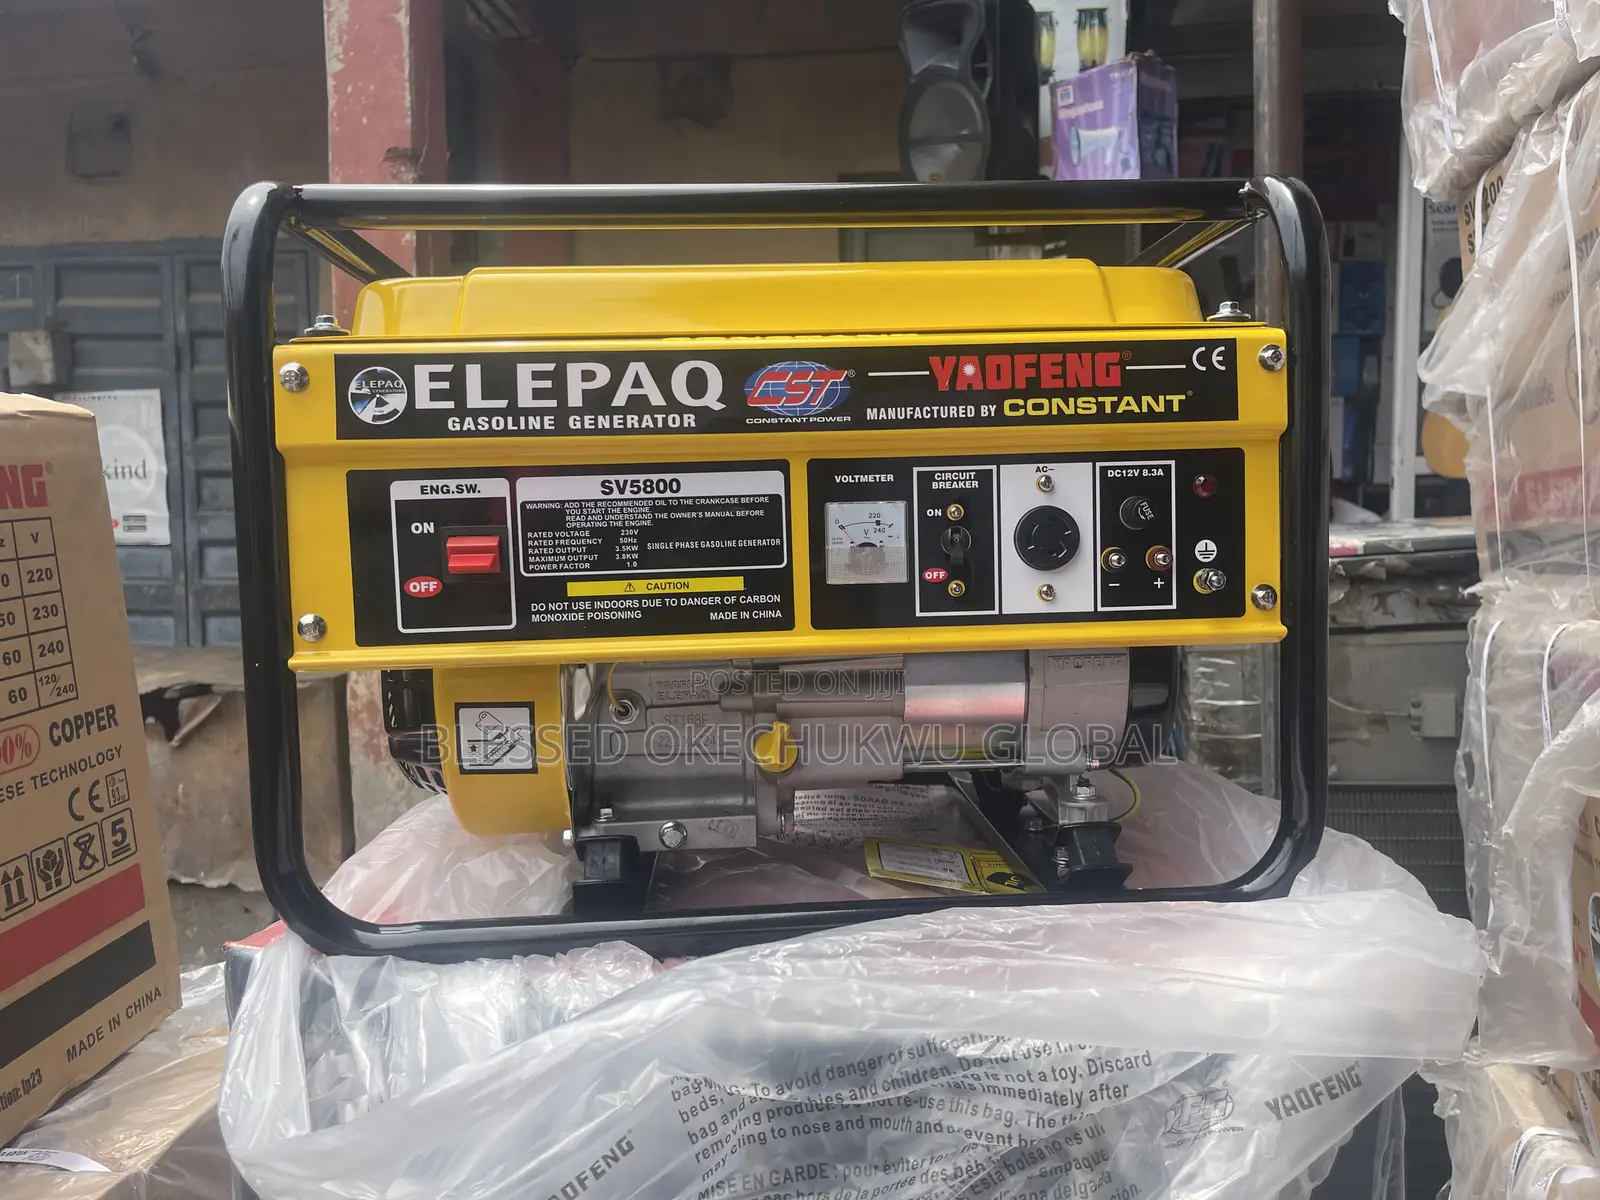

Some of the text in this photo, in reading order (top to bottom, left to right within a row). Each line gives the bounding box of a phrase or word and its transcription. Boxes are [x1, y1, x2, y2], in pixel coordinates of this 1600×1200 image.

[929, 351, 1121, 391] YAOFENG
[355, 380, 403, 389] ELEPAQ
[414, 360, 726, 411] ELEPAQ
[746, 369, 848, 407] CST
[866, 394, 1186, 421] MANUFACTURED BY CONSTANT
[447, 413, 696, 431] GASOLINE GENERATOR
[745, 416, 808, 424] CONSTANT
[835, 474, 894, 483] VOLTMETER
[934, 472, 976, 481] CIRCUIT
[1107, 468, 1164, 478] DC12V 8.3A
[420, 484, 481, 495] ENG.SW.
[600, 478, 681, 496] SV5800
[932, 480, 979, 489] BREAKER
[926, 508, 942, 517] ON
[1140, 501, 1155, 520] FUSE
[410, 521, 435, 534] ON
[620, 528, 639, 536] 230V
[30, 532, 40, 544] V
[527, 539, 554, 547] RATED
[646, 538, 781, 550] SINGLE PHASE GASOLINE GENERATOR
[26, 566, 53, 584] 220
[559, 562, 590, 570] FACTOR
[924, 571, 946, 580] OFF
[409, 581, 438, 593] OFF
[646, 581, 690, 591] CAUTION
[32, 603, 59, 621] 230
[531, 594, 781, 612] DO NOT USE INDOORS DUE TO DANGER OF CARBON
[531, 610, 642, 622] MONOXIDE POISONING
[710, 609, 783, 621] MADE IN CHINA
[2, 639, 64, 666] 60 240
[7, 686, 28, 704] 60
[48, 703, 119, 747] COPPER
[30, 744, 123, 790] TECHNOLOGY
[112, 817, 128, 847] 5
[66, 986, 162, 1063] MADE IN CHINA
[775, 1067, 821, 1096] avoid
[826, 1055, 884, 1081] danger
[678, 1093, 724, 1124] beds,
[1038, 1071, 1047, 1082] a
[1051, 1064, 1083, 1083] toy.
[1087, 1050, 1153, 1076] Discard
[1264, 1065, 1363, 1121] YAOFENG
[687, 1082, 1129, 1145] bag and immediately after
[694, 1109, 761, 1164] removing
[948, 1097, 979, 1116] this
[983, 1102, 1018, 1128] bag.
[1025, 1110, 1056, 1129] The
[701, 1114, 943, 1182] may cling to nose and mouth and
[742, 1173, 764, 1191] EN
[769, 1163, 829, 1186] GARDE
